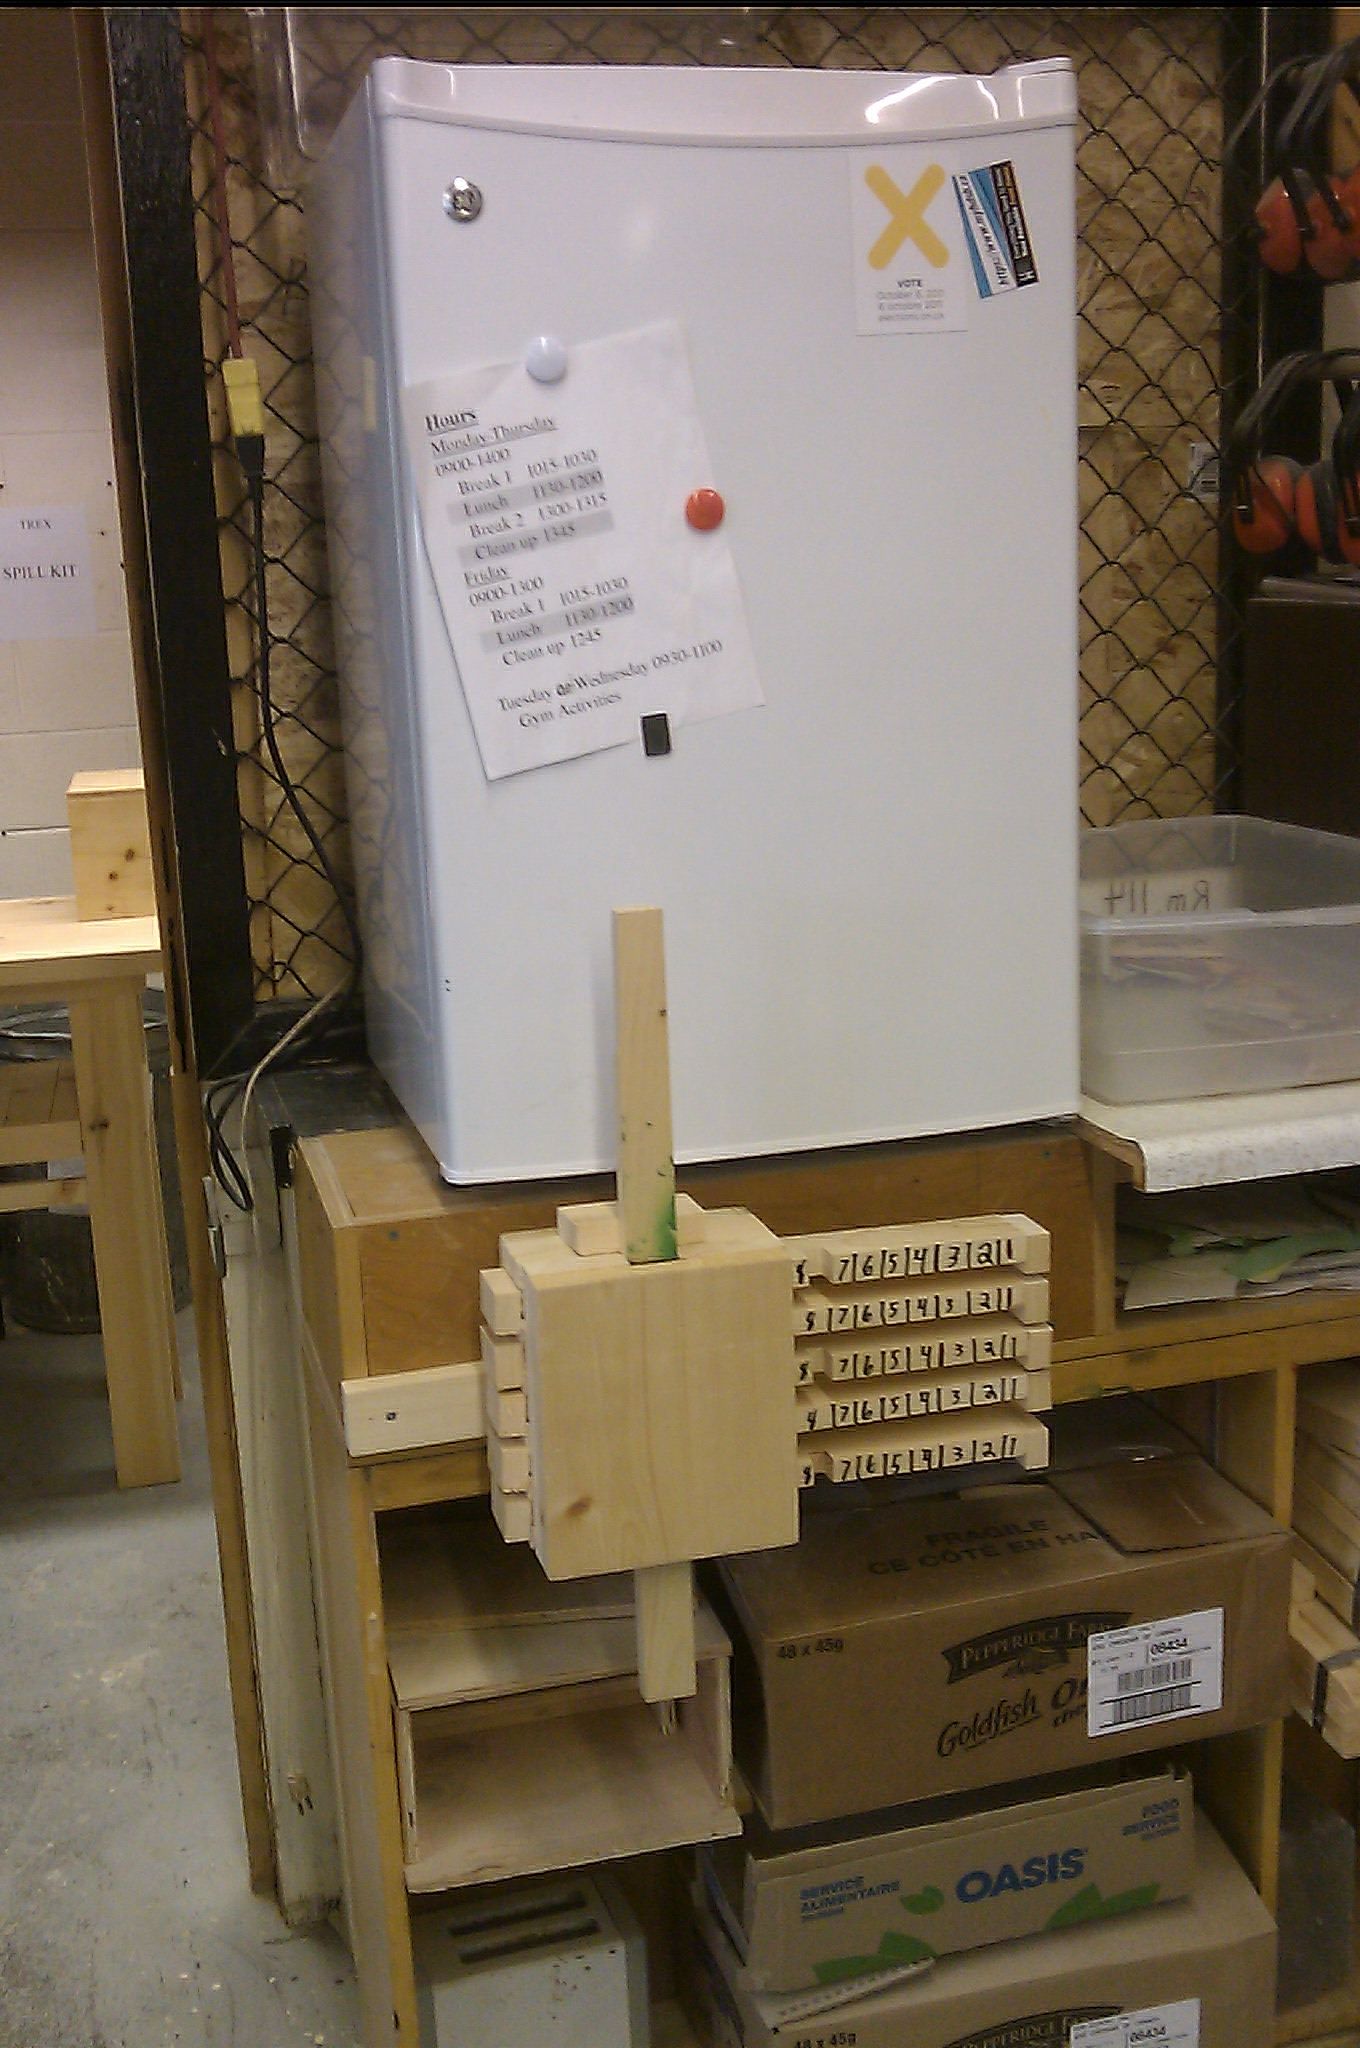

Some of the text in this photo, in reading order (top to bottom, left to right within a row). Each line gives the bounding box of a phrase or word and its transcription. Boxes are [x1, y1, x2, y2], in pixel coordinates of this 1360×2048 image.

[425, 410, 476, 431] Hours
[457, 474, 498, 493] Break
[463, 495, 506, 515] Lunch
[469, 517, 511, 537] Break
[474, 538, 517, 558] Clean
[3, 565, 76, 579] SPILL KIT
[464, 566, 506, 584] Friday
[491, 603, 531, 621] Break
[497, 624, 540, 643] Lunch
[502, 645, 544, 664] Clean
[498, 687, 551, 711] Tuesday
[574, 661, 646, 690] Wednesday
[519, 691, 621, 727] Gym Activities
[926, 1520, 1049, 1546] FRAGILE
[868, 1558, 910, 1575] CE
[1007, 1537, 1050, 1553] EN
[1056, 1531, 1100, 1546] HA
[938, 1688, 1040, 1757] Goldfish
[956, 1848, 1085, 1903] OASIS
[800, 1876, 864, 1900] SERVICE
